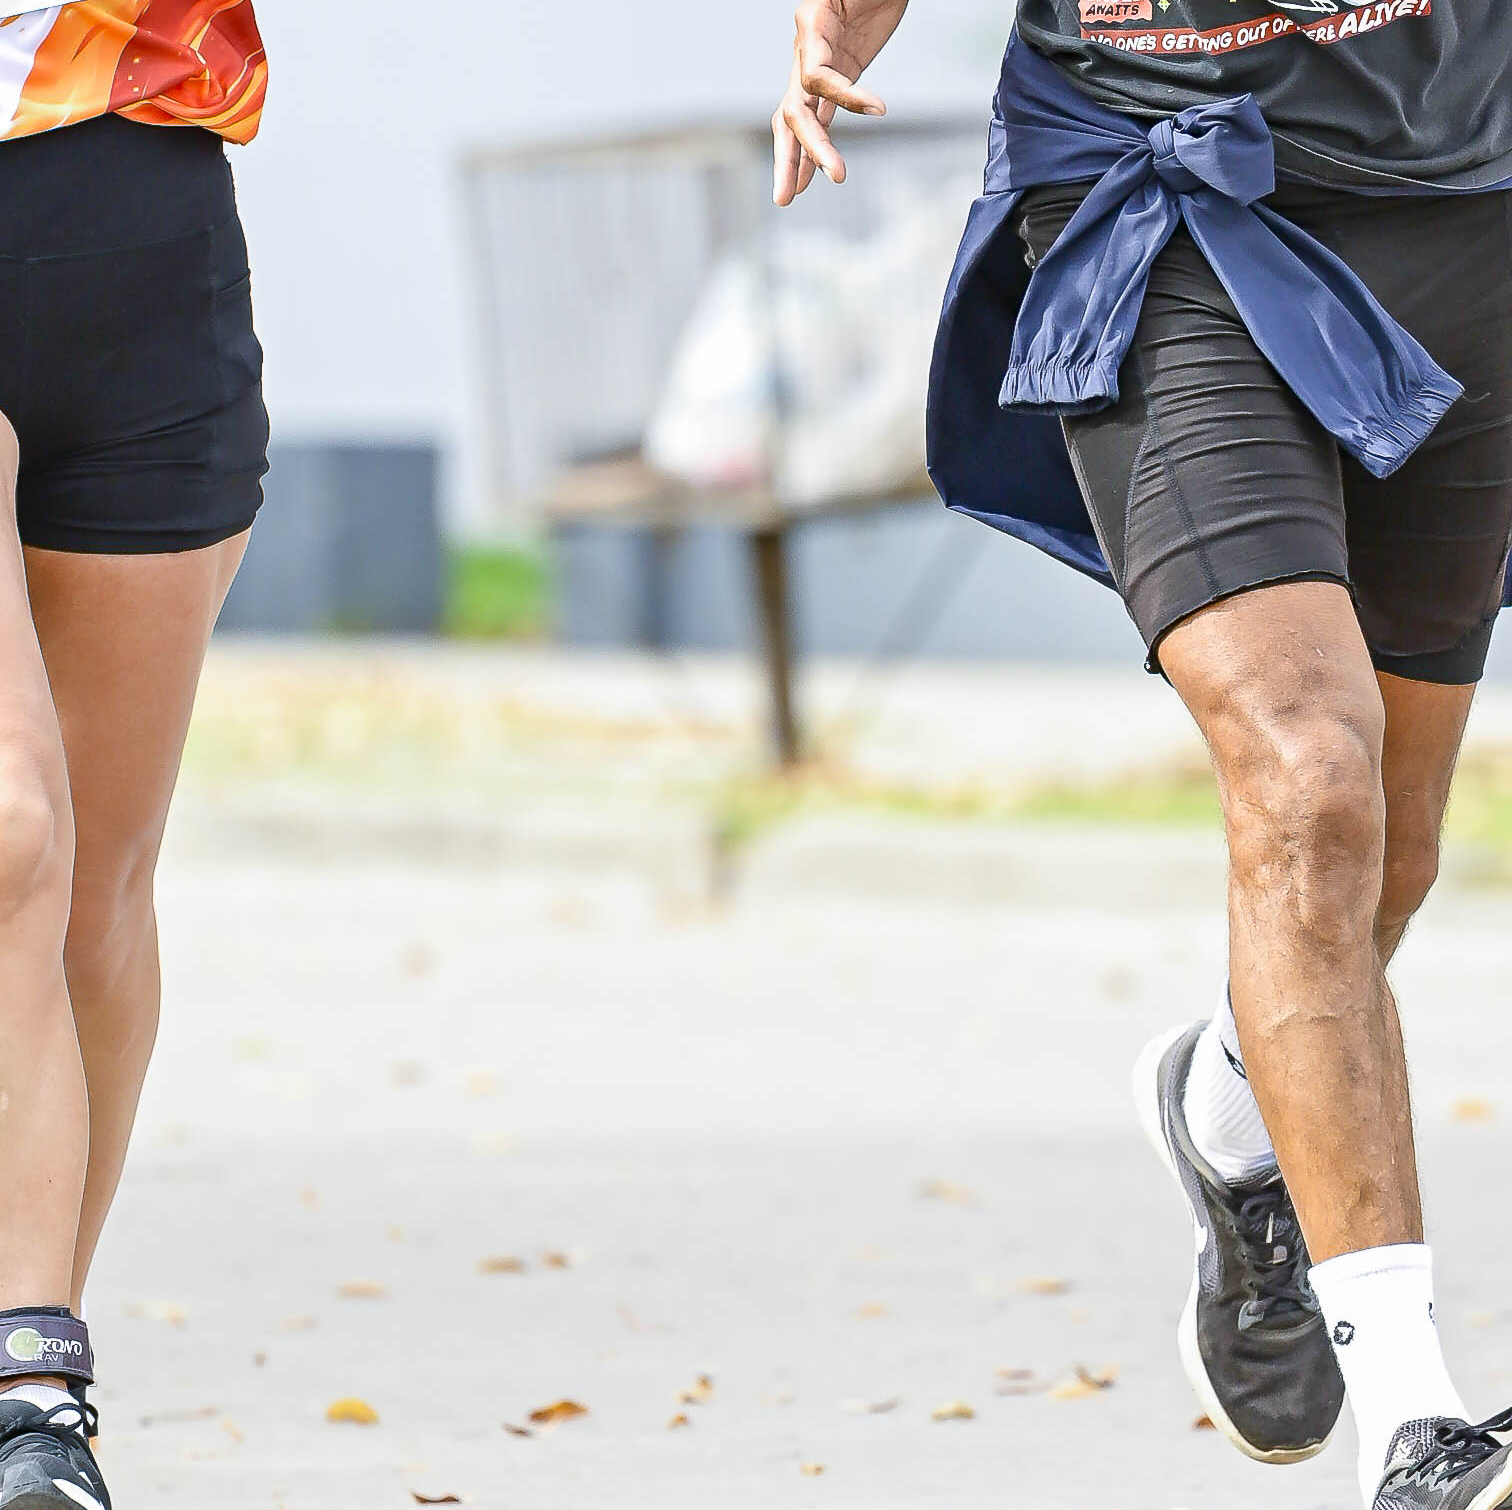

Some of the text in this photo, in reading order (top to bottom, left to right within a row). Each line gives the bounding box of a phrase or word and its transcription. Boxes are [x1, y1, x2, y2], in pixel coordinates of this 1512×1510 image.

[1086, 4, 1140, 16] AWAITS
[1116, 34, 1157, 51] ONE'S
[1236, 21, 1270, 46] OUT
[1297, 24, 1337, 42] ERE
